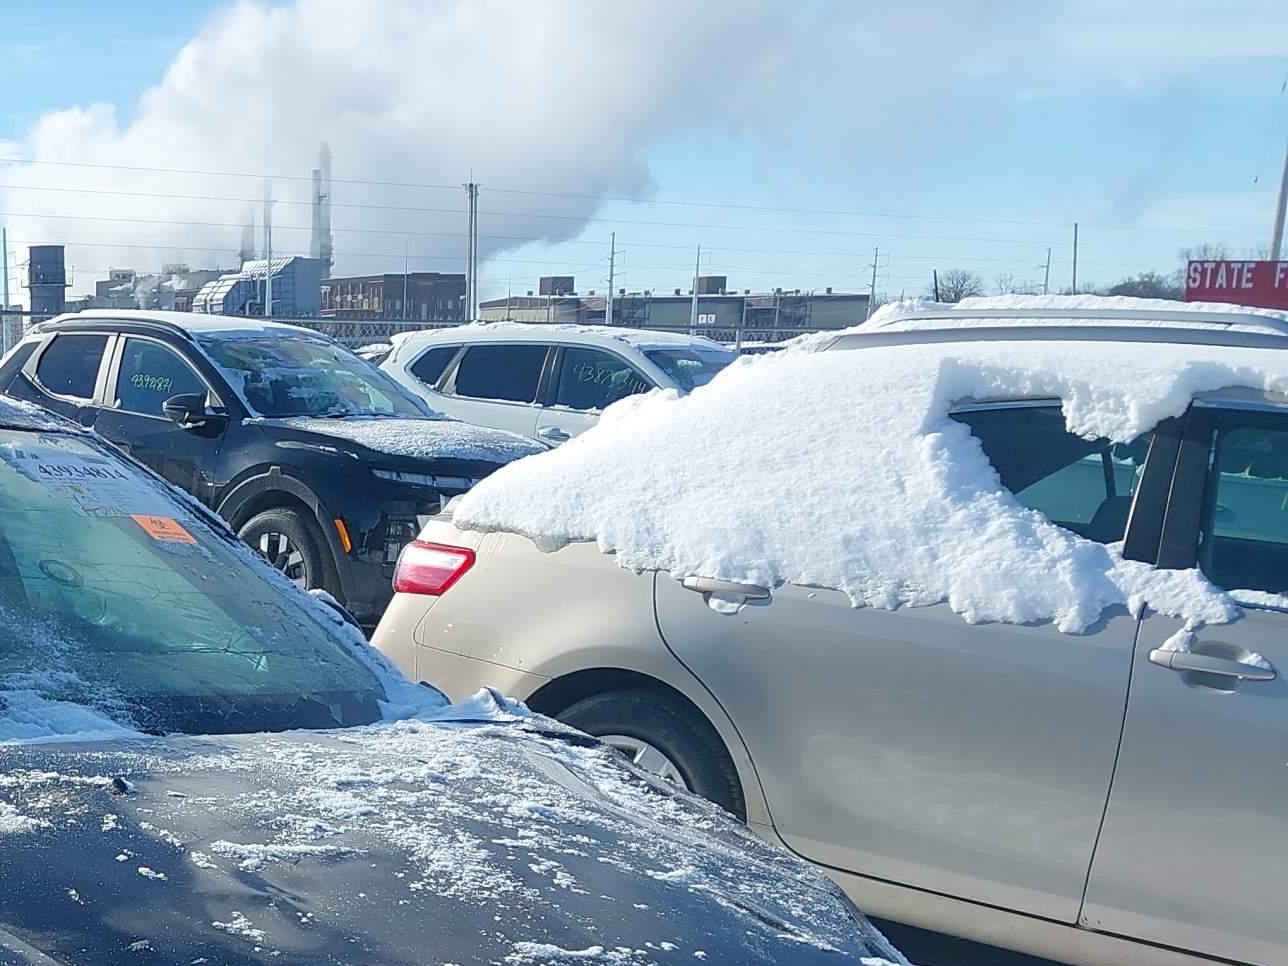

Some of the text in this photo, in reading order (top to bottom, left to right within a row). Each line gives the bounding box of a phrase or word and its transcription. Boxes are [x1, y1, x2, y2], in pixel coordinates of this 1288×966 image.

[1188, 262, 1288, 289] STATE F
[38, 464, 129, 481] 43934814
